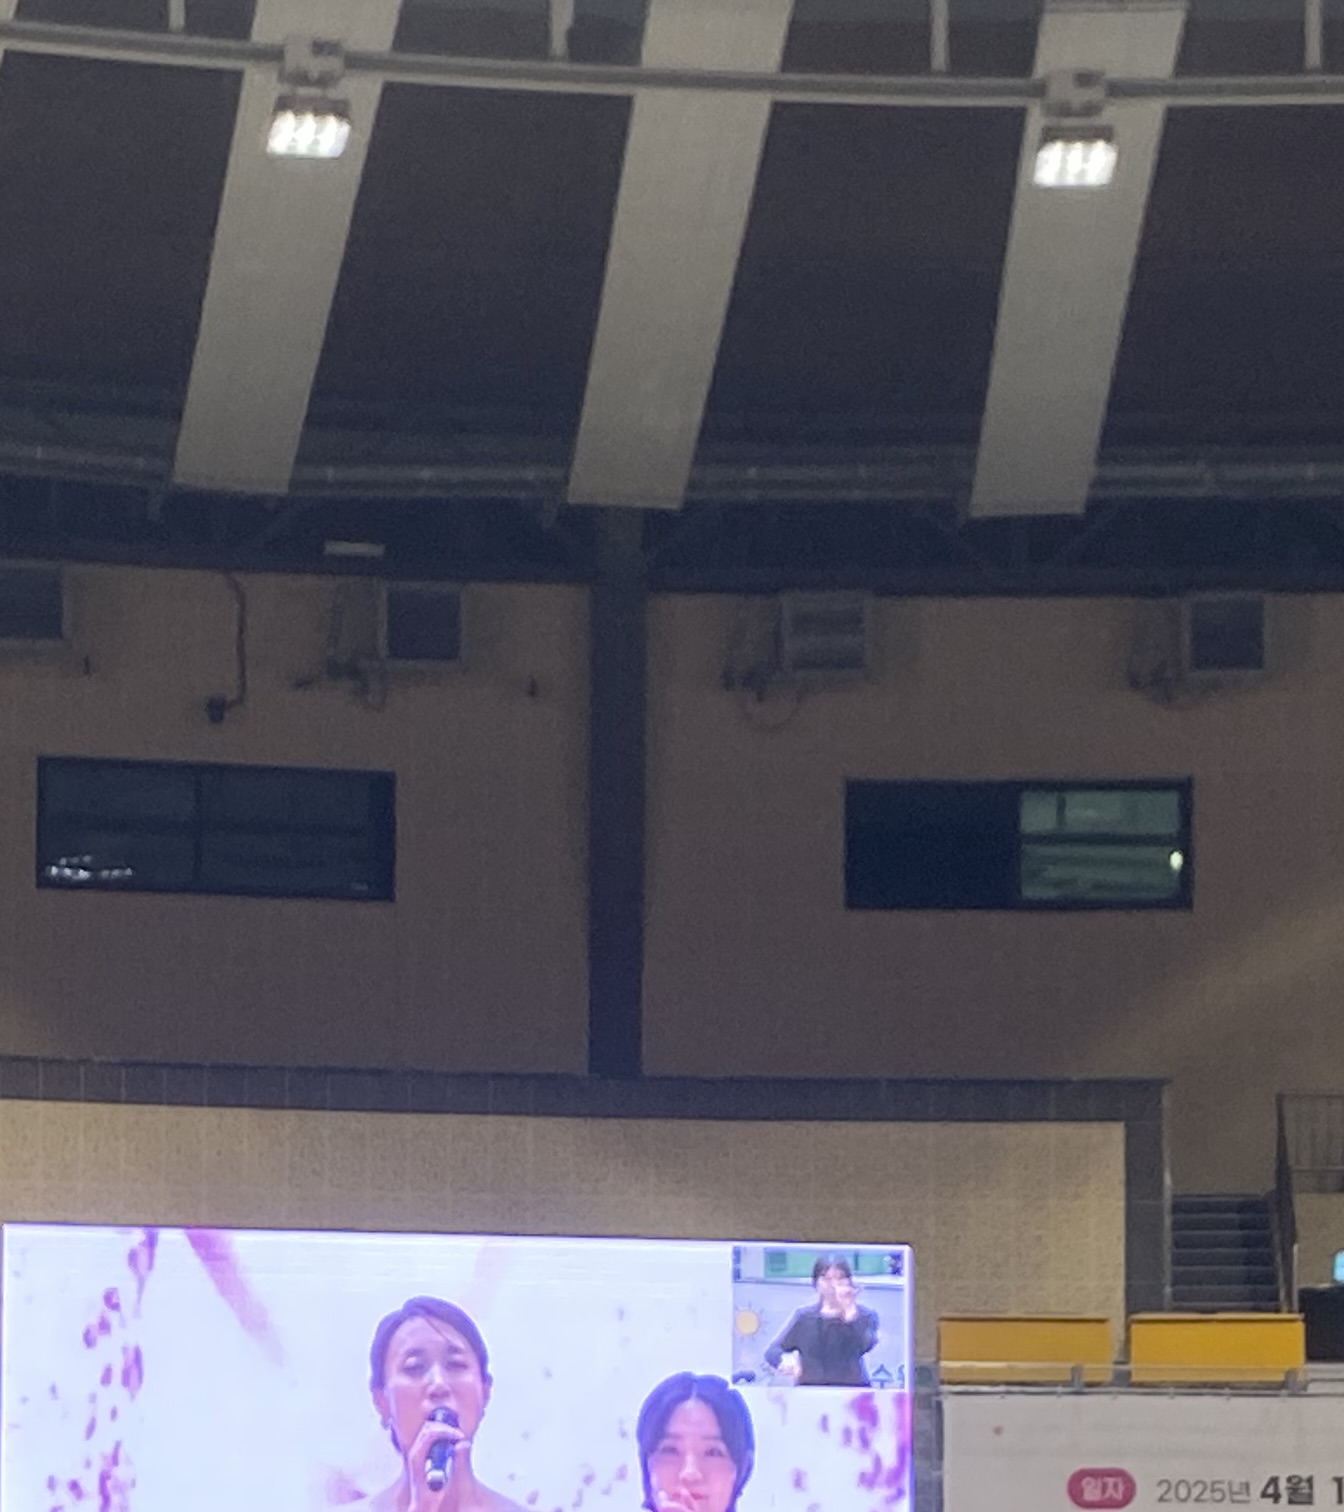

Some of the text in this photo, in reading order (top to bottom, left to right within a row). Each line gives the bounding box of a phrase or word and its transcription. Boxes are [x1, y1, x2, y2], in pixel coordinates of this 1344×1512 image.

[1081, 1476, 1125, 1501] 일자
[1157, 1478, 1251, 1505] 2025년
[1260, 1475, 1314, 1506] 4월
